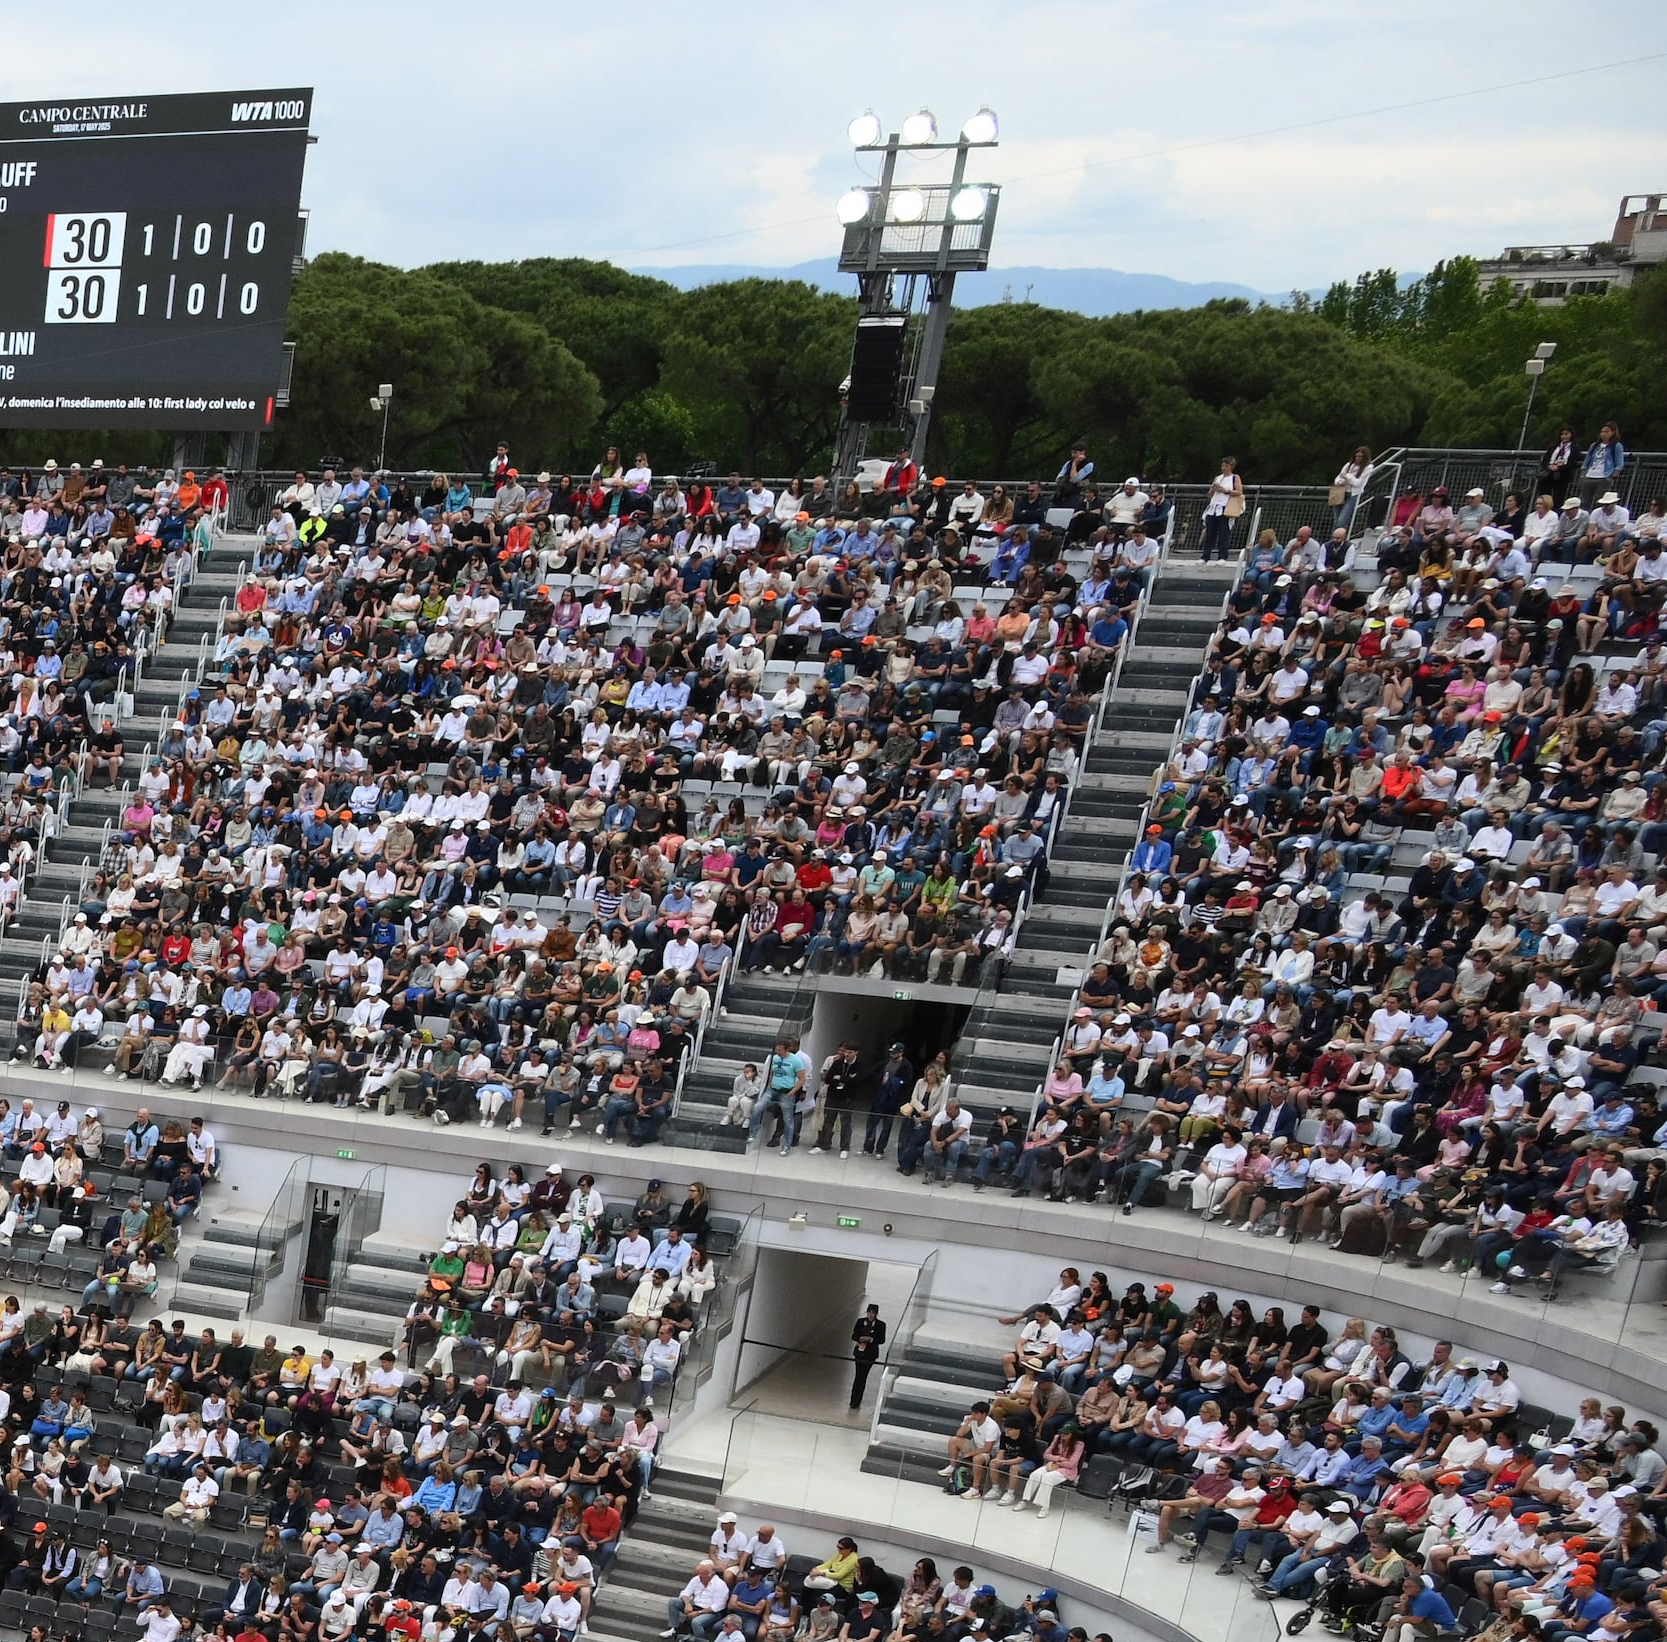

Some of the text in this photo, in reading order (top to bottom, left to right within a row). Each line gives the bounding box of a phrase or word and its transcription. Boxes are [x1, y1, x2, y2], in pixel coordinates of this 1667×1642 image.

[19, 103, 148, 123] CAMPO CENTRALE
[63, 218, 266, 264] 30 1 0 0
[57, 275, 259, 320] 30 1 0 0
[8, 397, 54, 408] domenica
[128, 397, 146, 409] alle
[148, 398, 163, 409] 10:
[164, 397, 184, 409] first
[185, 398, 207, 412] lady
[208, 398, 224, 410] col
[225, 398, 247, 410] velo
[248, 401, 256, 410] e
